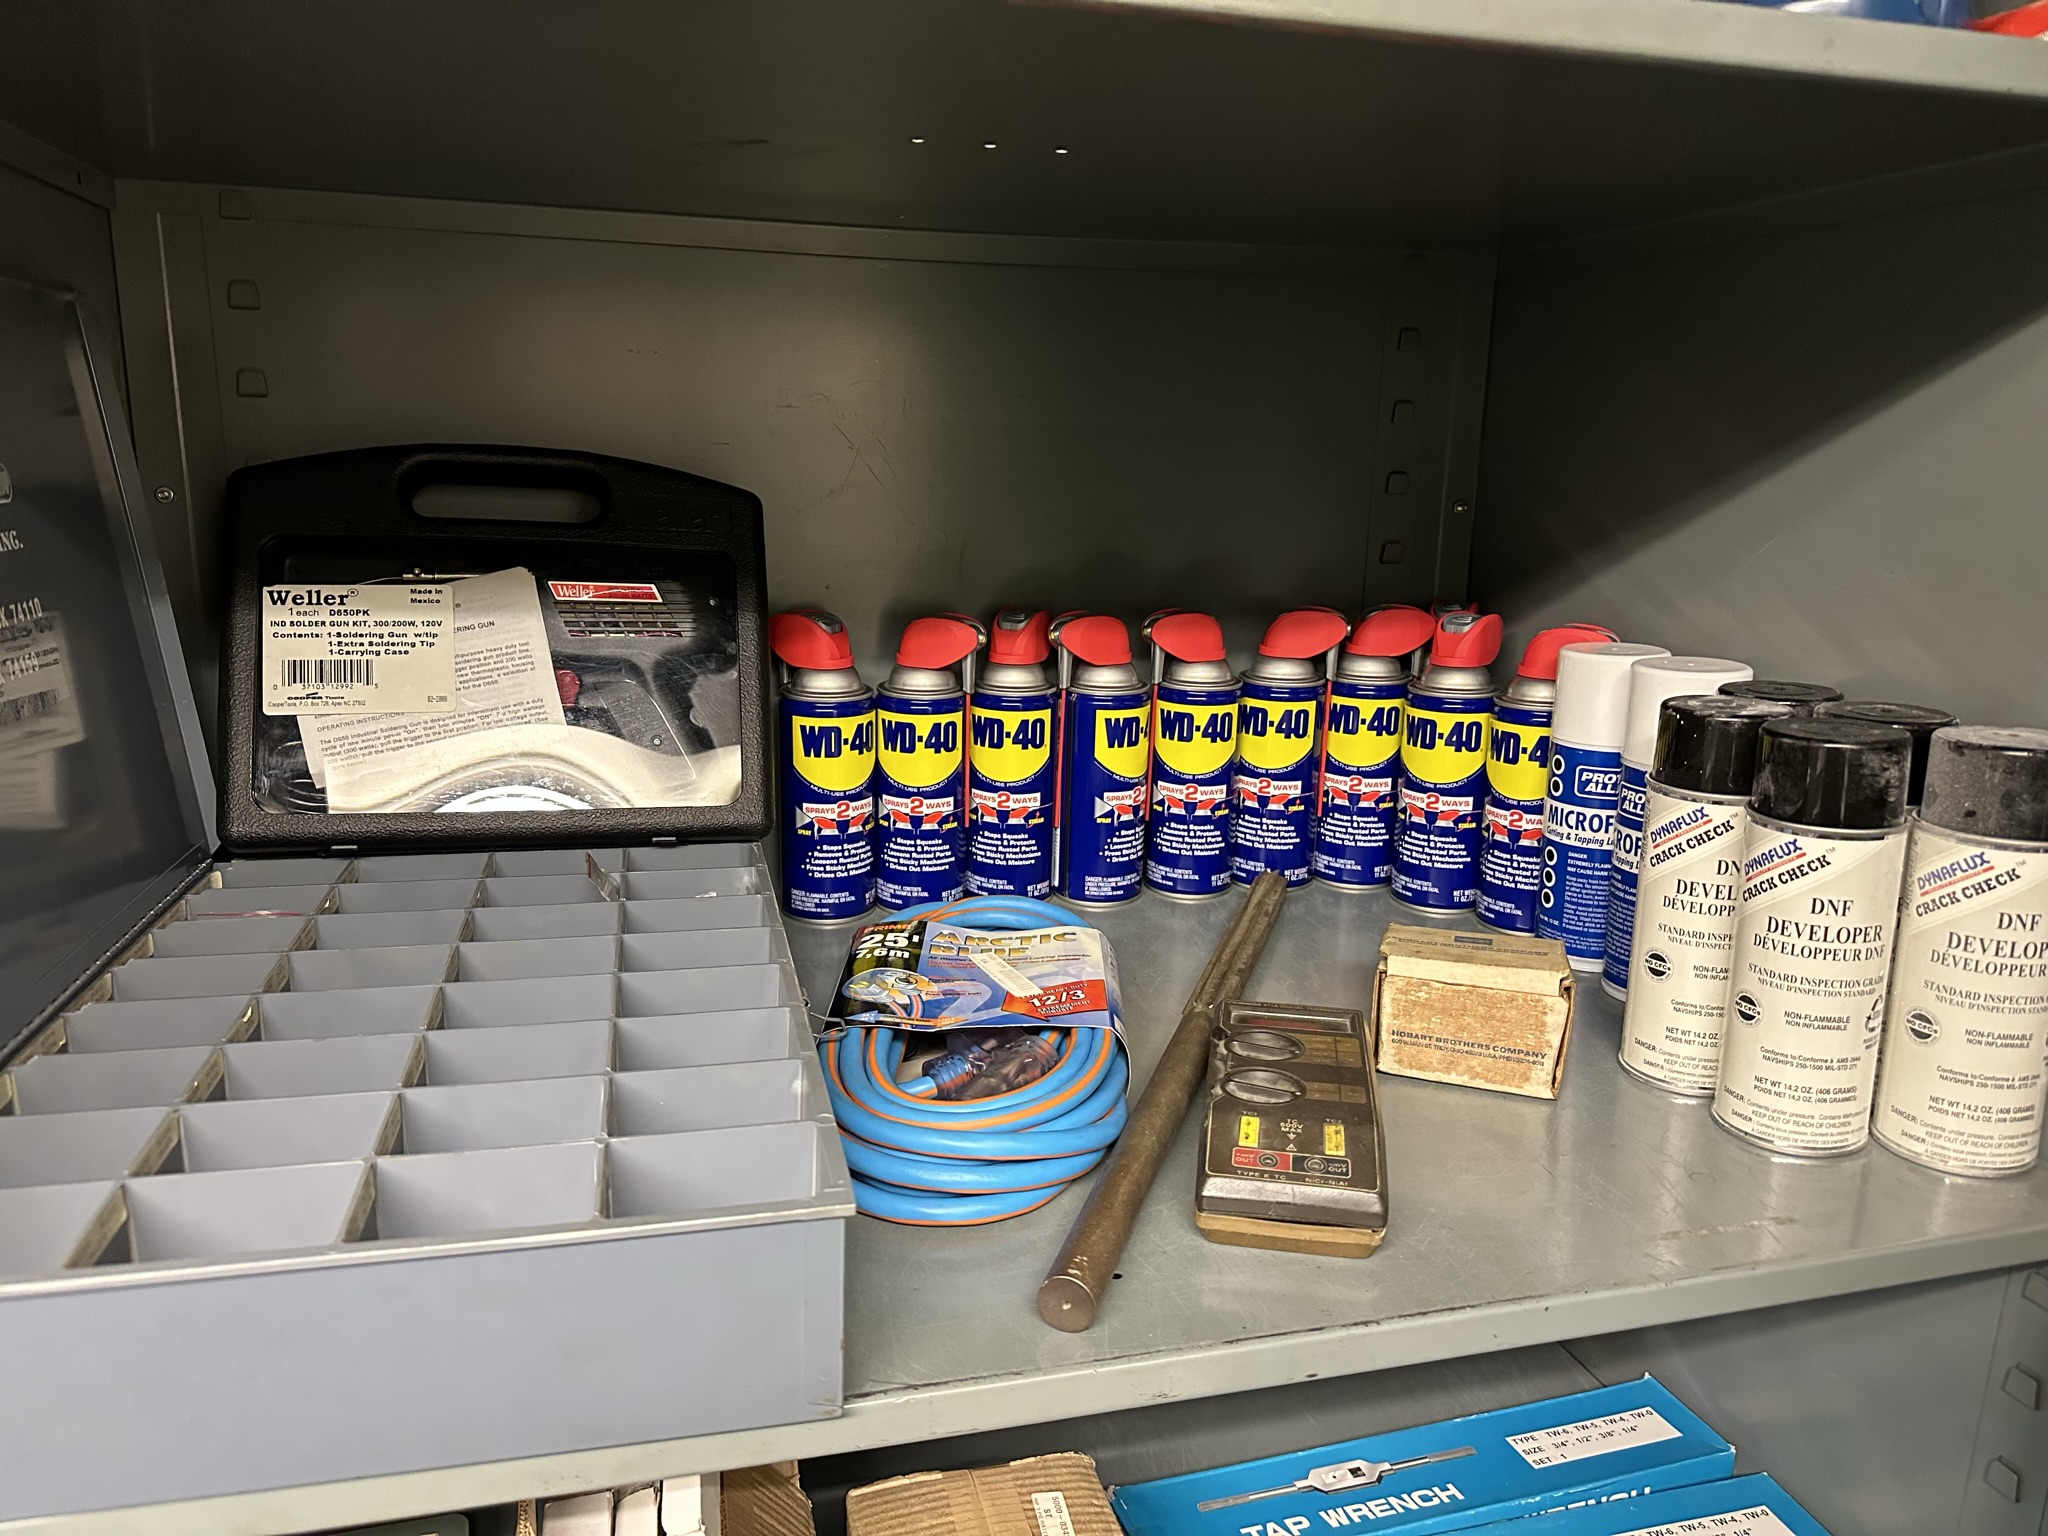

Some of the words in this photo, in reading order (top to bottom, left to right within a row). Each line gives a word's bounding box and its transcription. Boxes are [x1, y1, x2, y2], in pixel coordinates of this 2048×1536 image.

[557, 585, 595, 598] Weller
[9, 598, 43, 624] 74110
[288, 608, 294, 616] 1
[296, 609, 319, 617] each
[329, 609, 370, 617] D650PK
[270, 620, 287, 628] IND
[289, 620, 326, 628] SOLDER
[329, 620, 350, 628] GUN
[352, 620, 371, 629] KIT,
[373, 620, 419, 629] 300/200W,
[421, 620, 443, 628] 120V
[477, 620, 495, 630] GUN
[272, 631, 323, 639] Contents:
[326, 631, 384, 640] 1-Soldering
[413, 631, 439, 640] w/tip
[328, 640, 365, 648] 1-Extra
[367, 640, 416, 649] Soldering
[419, 640, 436, 649] Tip
[329, 648, 381, 657] 1-Carrying
[384, 648, 410, 656] Case
[317, 721, 355, 733] OPERATING
[1159, 707, 1233, 744] WD-40
[1238, 703, 1310, 740] WD-40
[1328, 702, 1401, 737] WD-40
[799, 719, 875, 759] WD-40
[881, 717, 958, 755] WD-40
[970, 713, 1045, 750] WD-40
[1405, 713, 1483, 753] WD-40
[1490, 726, 1550, 769] WD-4
[888, 777, 918, 793] MULTI-USE
[919, 779, 949, 793] PRODUCT
[1258, 778, 1271, 795] 2
[1273, 783, 1299, 791] WAYS
[1407, 772, 1435, 790] MULTI-USE
[1436, 778, 1468, 790] PRODUCT
[972, 792, 997, 803] SPRAYS
[997, 792, 1011, 809] 2
[1012, 795, 1038, 804] WAYS
[1159, 784, 1184, 795] SPRAYS
[1185, 784, 1199, 801] 2
[1200, 788, 1225, 796] WAYS
[1402, 791, 1425, 804] SPRAYS
[1425, 793, 1440, 811] 2
[1442, 799, 1470, 808] WAYS
[804, 806, 836, 815] SPRAYS
[836, 801, 850, 819] 2
[852, 801, 872, 813] WAYS
[884, 799, 909, 810] SPRAYS
[910, 798, 924, 815] 2
[925, 800, 951, 810] WAYS
[1547, 804, 1615, 834] MICROF
[1650, 806, 1710, 844] DYNAFLUX
[1547, 825, 1564, 840] Cutting
[1565, 832, 1572, 840] &
[1574, 834, 1604, 847] Tapping
[920, 857, 955, 865] Mechanisms
[1650, 842, 1687, 868] CRACK
[1744, 838, 1803, 877] DYNAFLUX
[922, 864, 949, 872] Moisture
[1916, 851, 1991, 892] DYNAFLUX
[1676, 878, 1738, 901] DEVEL
[1742, 876, 1778, 903] CRACK
[1663, 894, 1735, 917] DÉVELOPP
[1810, 897, 1854, 917] DNF
[1915, 890, 1961, 918] CRACK
[864, 924, 911, 934] PRIME
[1766, 915, 1883, 945] DEVELOPER
[1997, 911, 2043, 932] DNF
[858, 932, 920, 950] 25'
[930, 930, 1078, 948] ARCTIC
[1753, 933, 1862, 962] DÉVELOPPEUR
[1864, 944, 1886, 961] DNF
[1947, 930, 2048, 960] DEVELOP
[1930, 949, 2048, 978] DÉVELOPPEUR
[1748, 963, 1798, 985] STANDARD
[1800, 977, 1861, 989] INSPECTION
[1046, 986, 1068, 995] HEAVY
[1069, 983, 1088, 991] DUTY
[1758, 977, 1785, 991] NIVEAU
[1786, 984, 1842, 998] D'INSPECTION
[1843, 988, 1876, 998] STANDARD
[1027, 989, 1086, 1008] 12/3
[1784, 1010, 1850, 1024] NON-FLAMMABLE
[1391, 1029, 1434, 1042] HOBART
[1435, 1036, 1490, 1051] BROTHERS
[1492, 1045, 1547, 1060] COMPANY
[1964, 1028, 2034, 1041] NON-FLAMMABLE
[1754, 1075, 1768, 1085] NET
[1770, 1080, 1781, 1089] WT
[1784, 1082, 1799, 1092] 14.2
[1801, 1086, 1813, 1094] OZ.
[1751, 1109, 1767, 1120] KEEP
[1767, 1113, 1781, 1123] OUT
[1782, 1117, 1791, 1125] OF
[1793, 1118, 1814, 1128] REACH
[1235, 1156, 1254, 1164] OUT
[1511, 1434, 1538, 1446] TYPE
[1545, 1427, 1573, 1439] TW-6,
[1573, 1421, 1602, 1432] TW-5,
[1601, 1415, 1630, 1426] TW-4,
[1522, 1446, 1546, 1456] SIZE
[1532, 1456, 1553, 1467] SET
[1318, 1483, 1465, 1528] WRENCH
[1677, 1521, 1711, 1532] TW-5,
[1710, 1515, 1742, 1527] TW-4,
